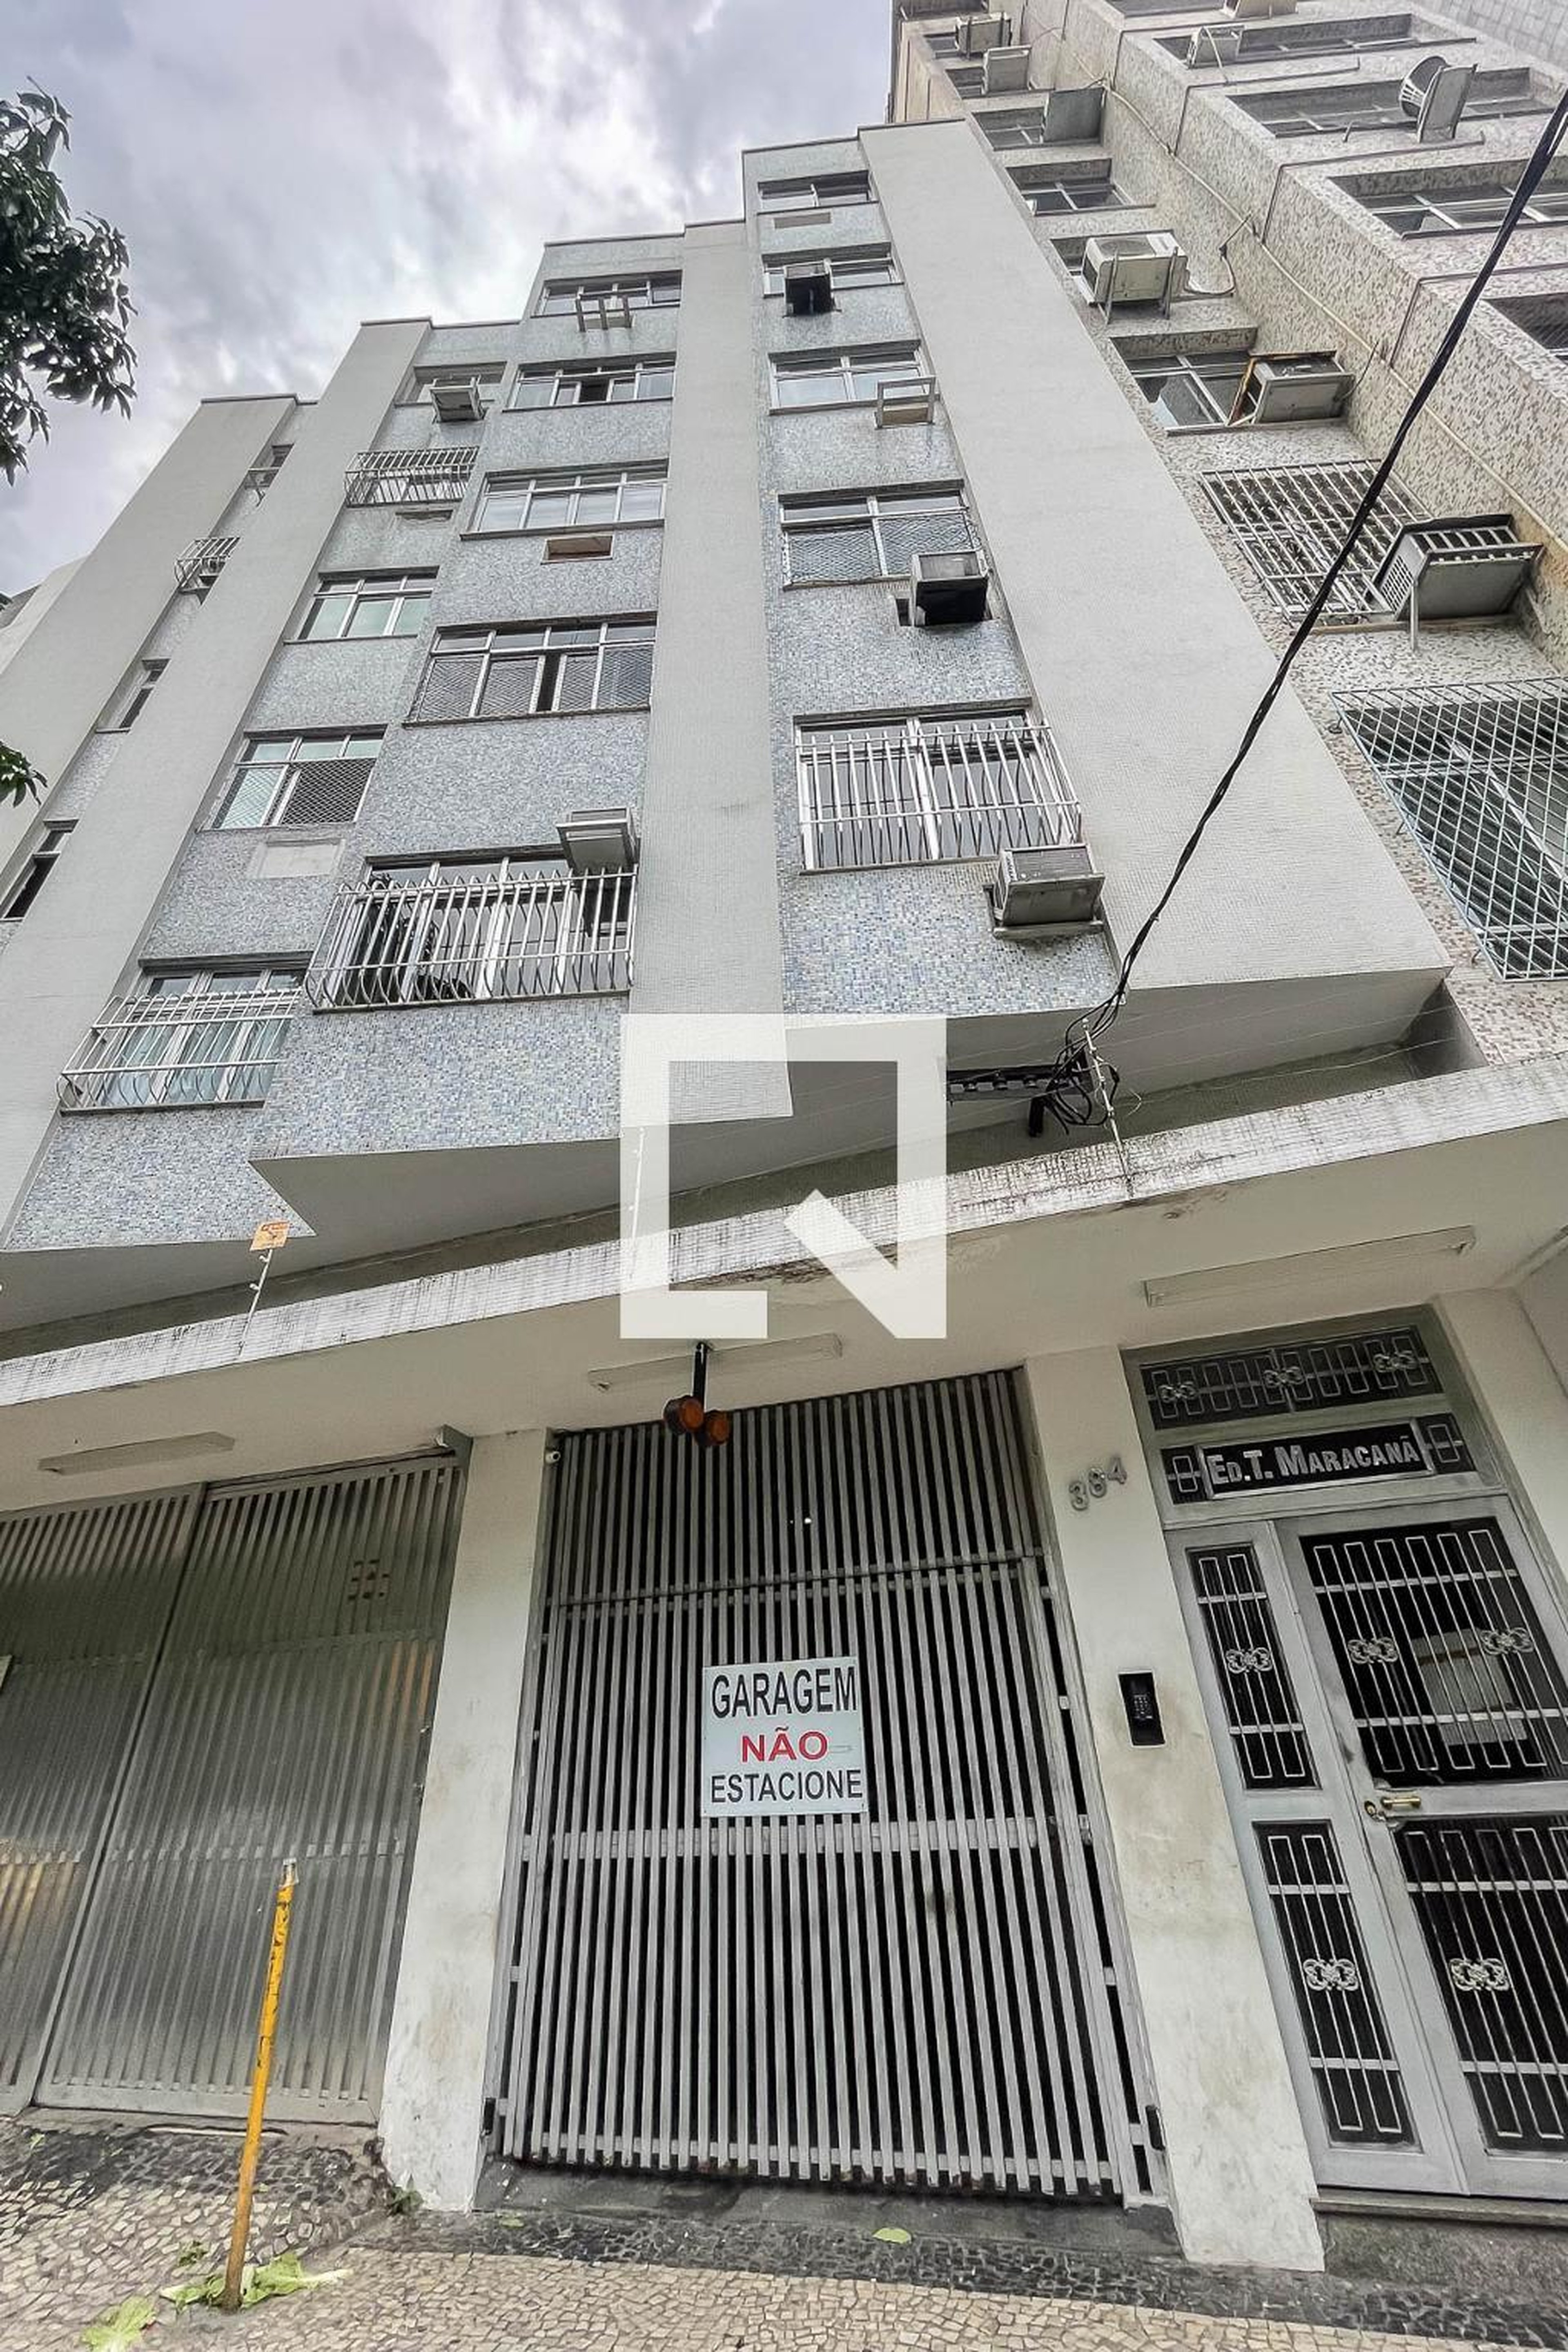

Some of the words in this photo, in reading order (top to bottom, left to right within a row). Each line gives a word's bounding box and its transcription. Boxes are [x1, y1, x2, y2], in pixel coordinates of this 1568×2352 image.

[712, 1667, 857, 1718] GARAGEM
[742, 1726, 828, 1762] NÃO
[711, 1769, 862, 1803] ESTACIONE
